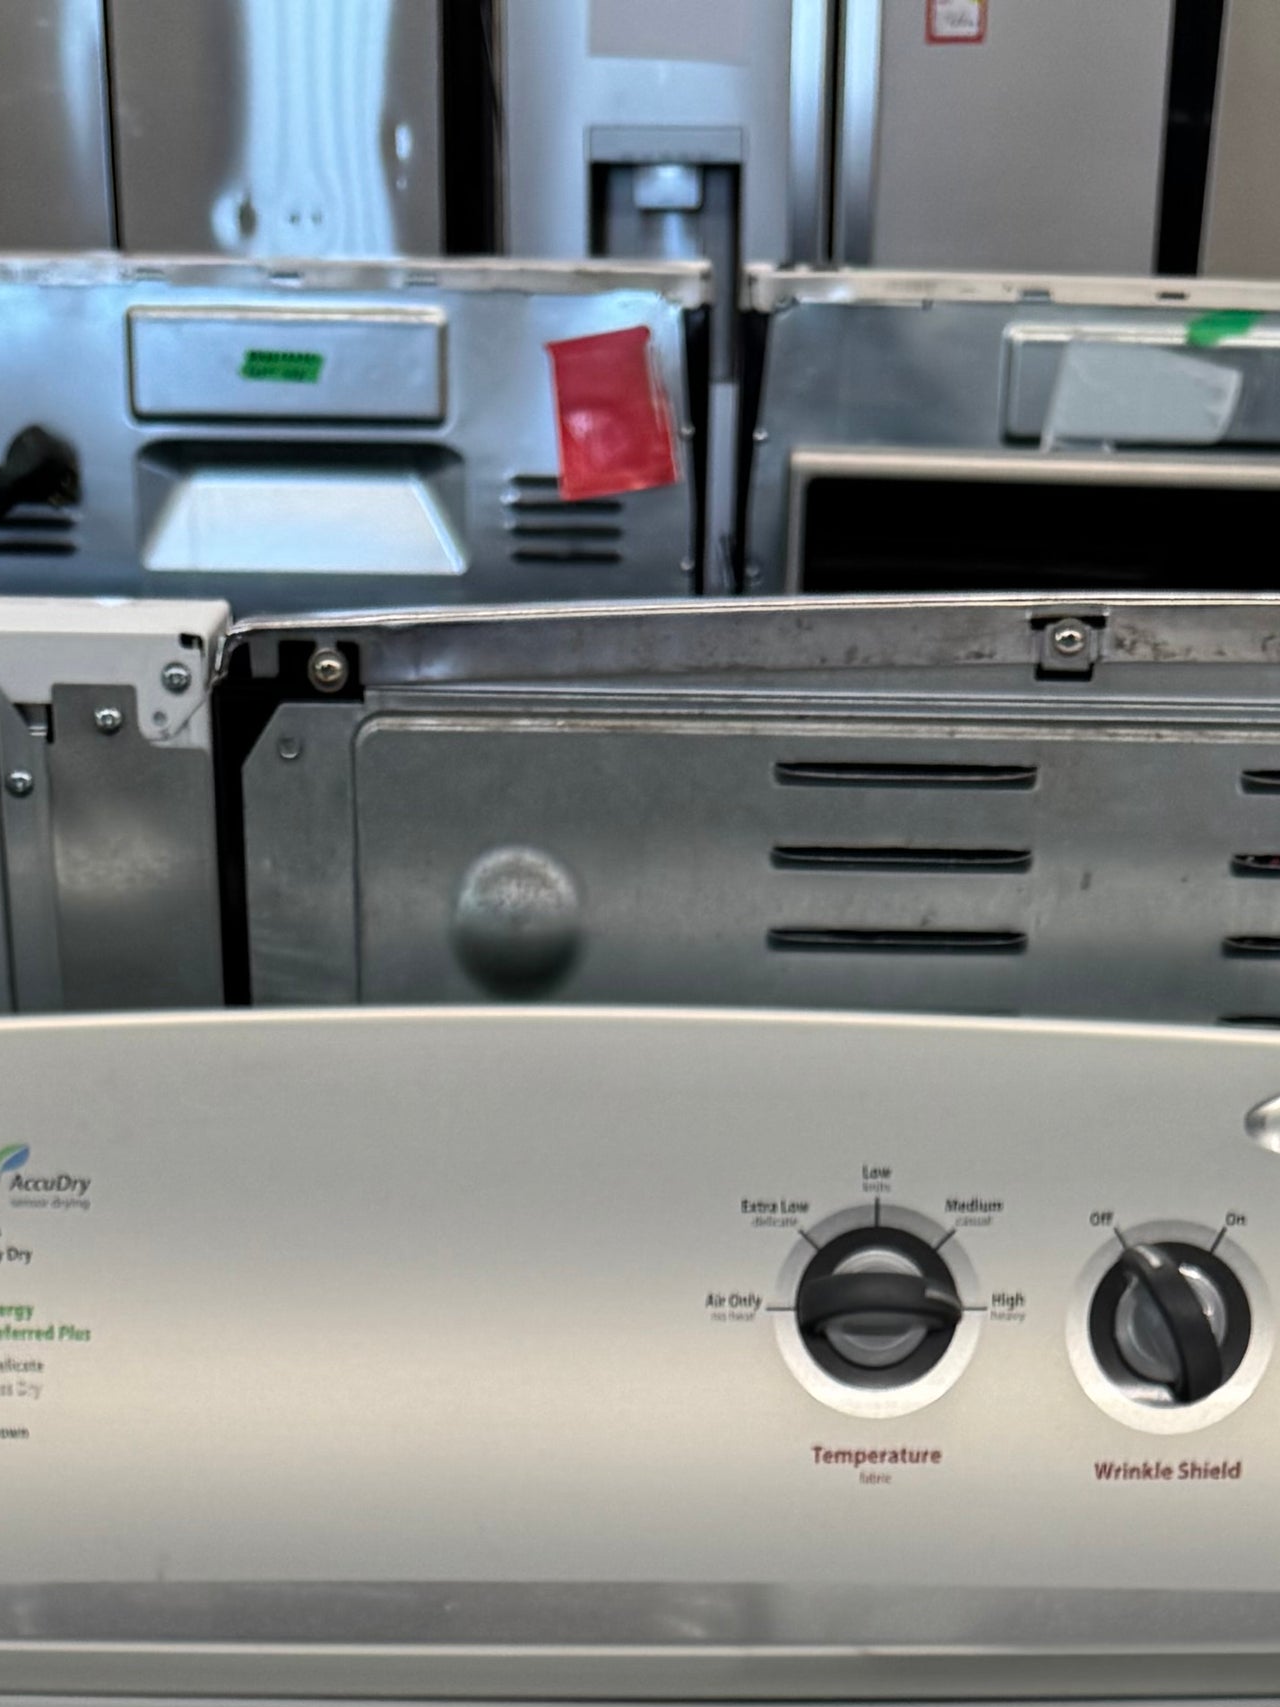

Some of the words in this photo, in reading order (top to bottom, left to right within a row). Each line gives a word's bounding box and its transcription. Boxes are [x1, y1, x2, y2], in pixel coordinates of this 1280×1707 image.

[862, 1166, 892, 1180] Low
[9, 1173, 91, 1197] AccuDry
[740, 1200, 777, 1214] Extra
[780, 1200, 811, 1214] Low
[945, 1200, 1004, 1213] Medium
[1089, 1210, 1115, 1227] Off
[1224, 1212, 1247, 1227] On
[6, 1246, 33, 1265] Dry
[705, 1293, 726, 1308] Air
[728, 1293, 762, 1311] Only
[991, 1293, 1026, 1310] High
[58, 1324, 91, 1342] Plus
[811, 1446, 943, 1468] Temperature
[1094, 1461, 1173, 1481] Wrinkle
[1177, 1460, 1242, 1481] Shield
